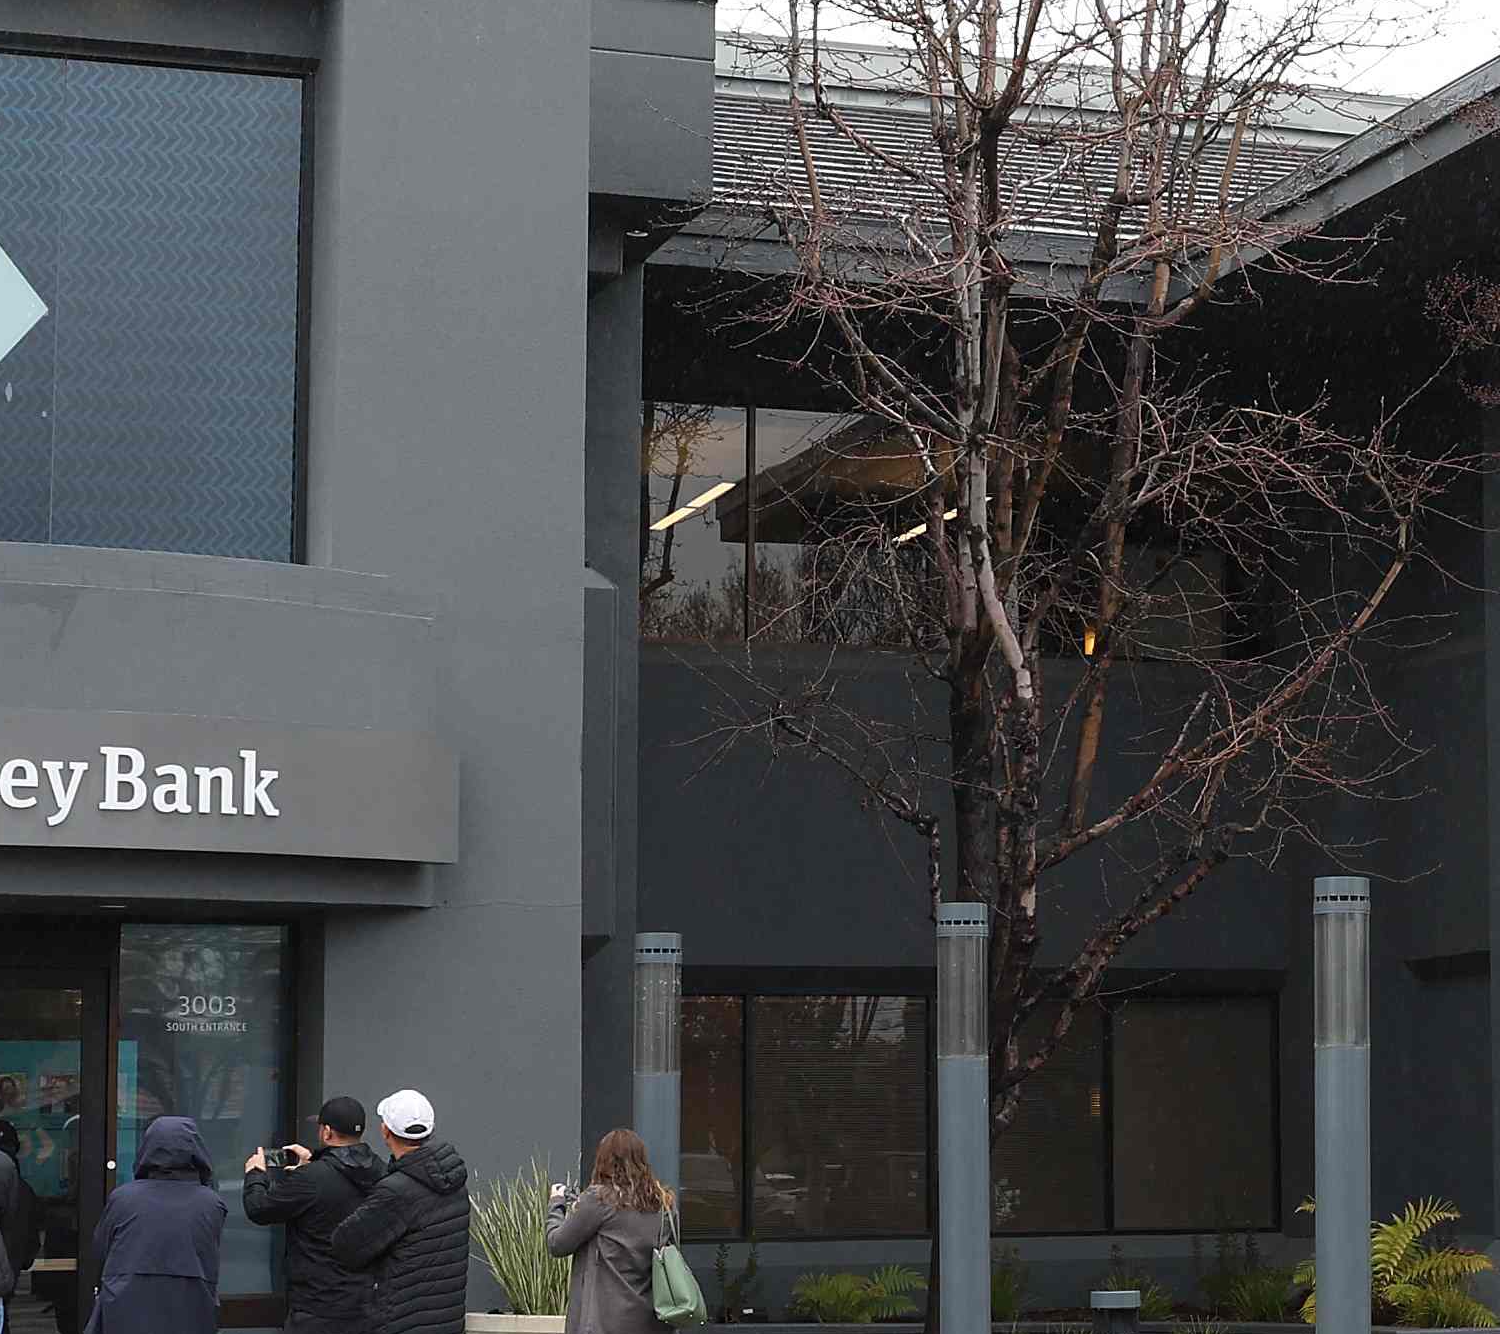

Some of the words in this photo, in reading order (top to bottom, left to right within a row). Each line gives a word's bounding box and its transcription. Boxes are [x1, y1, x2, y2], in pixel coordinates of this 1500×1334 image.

[98, 746, 280, 817] Bank
[178, 995, 237, 1016] 3003
[165, 1022, 198, 1032] SOUTH
[199, 1022, 248, 1032] ENTRANCE
